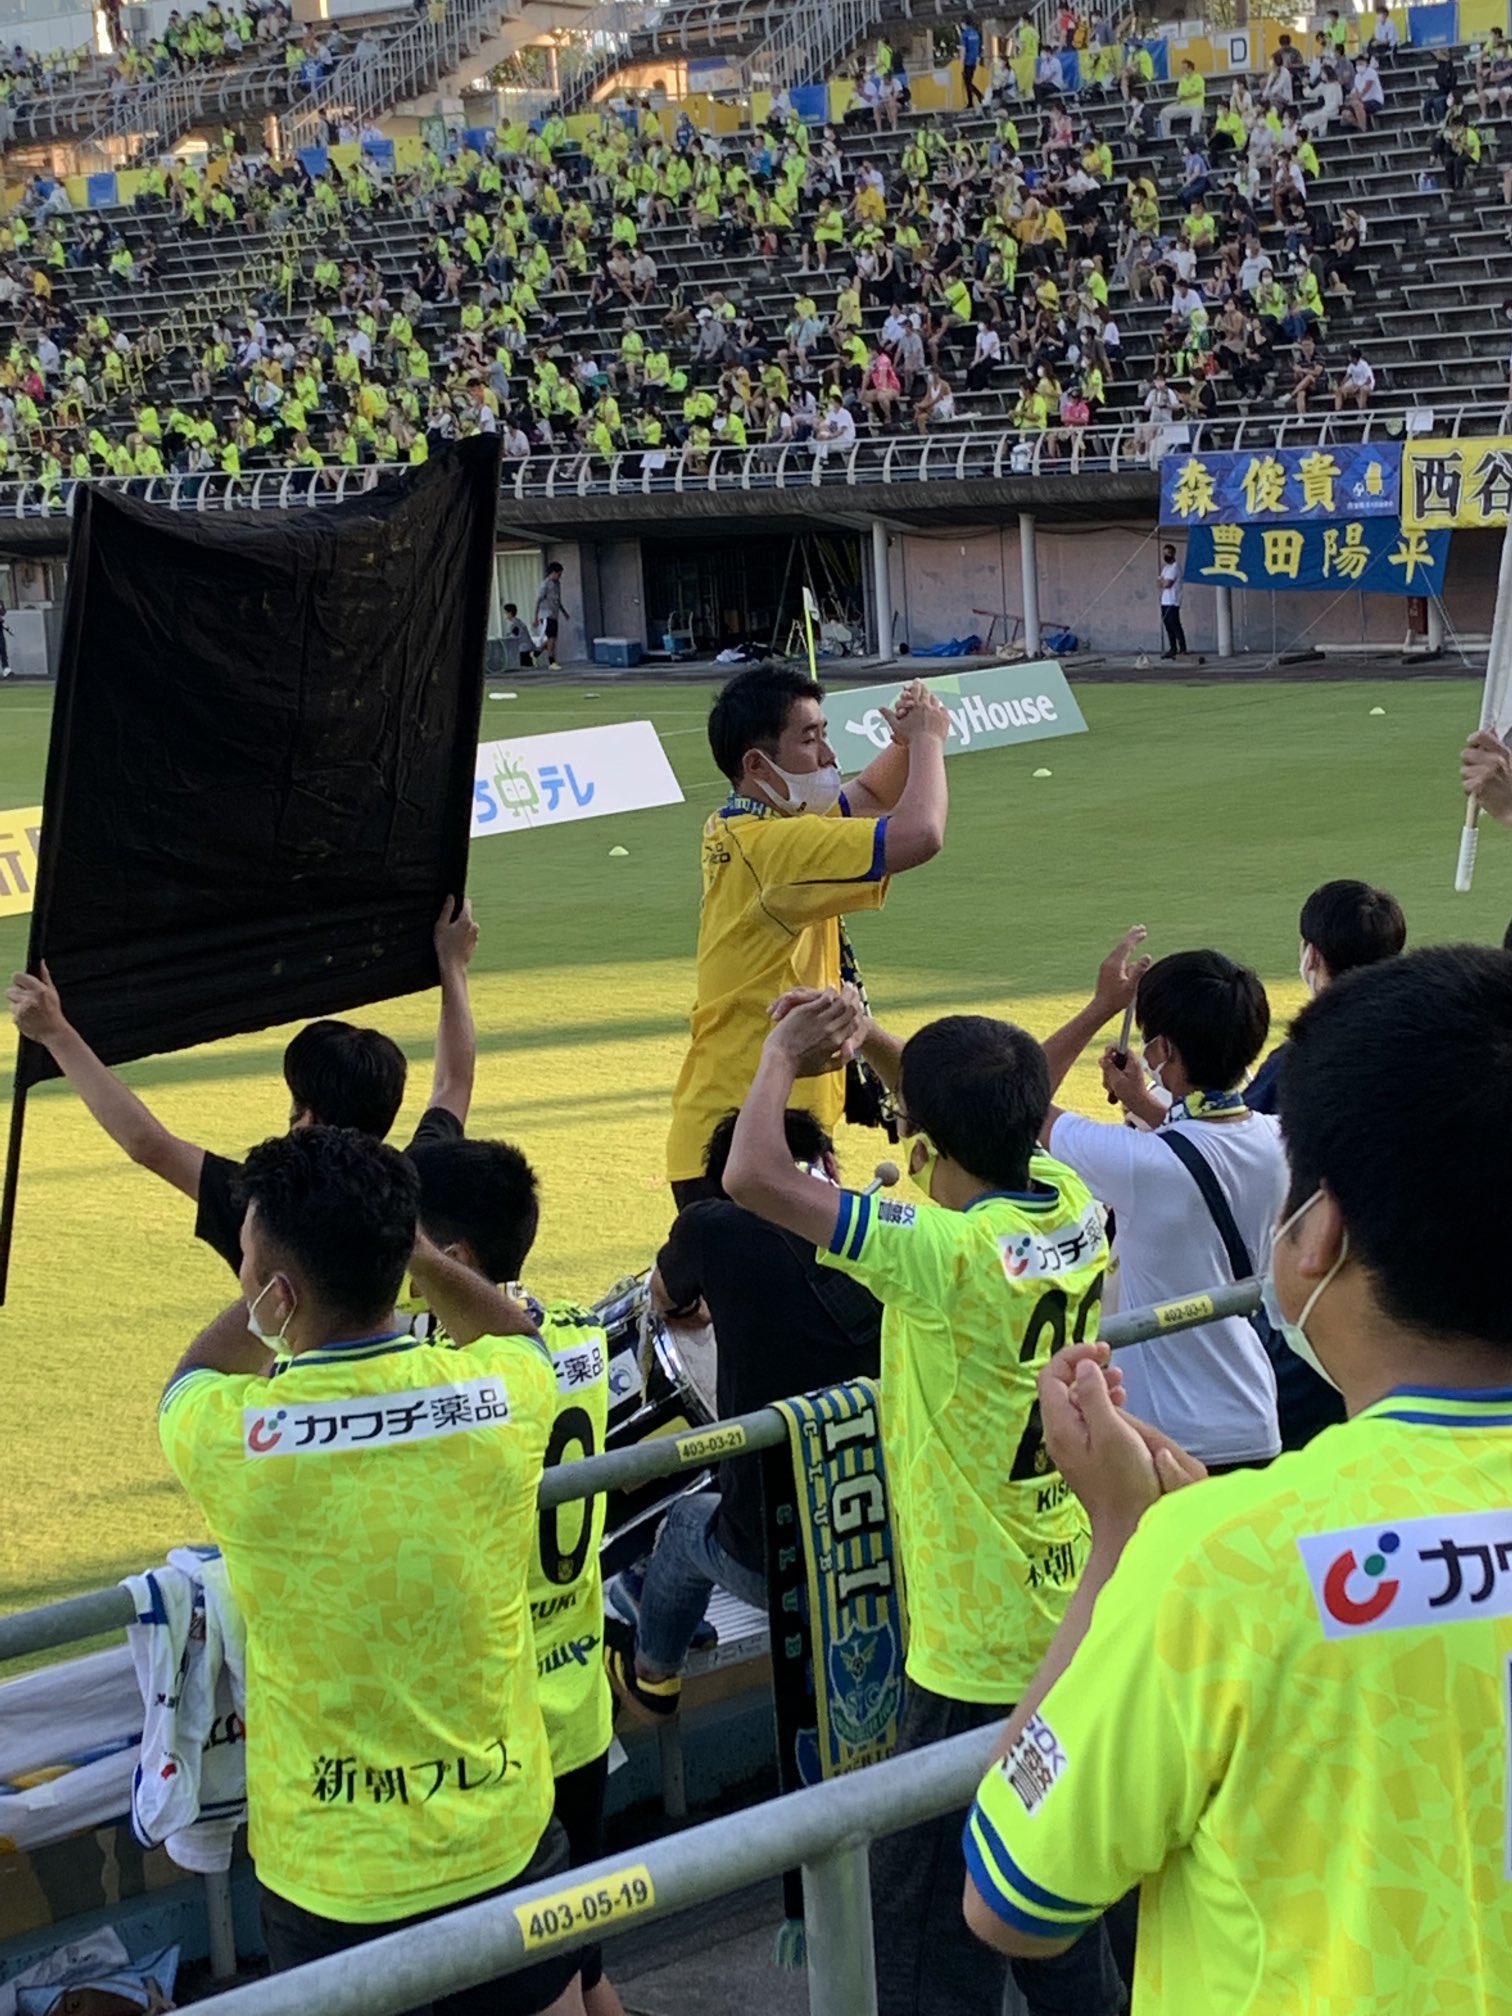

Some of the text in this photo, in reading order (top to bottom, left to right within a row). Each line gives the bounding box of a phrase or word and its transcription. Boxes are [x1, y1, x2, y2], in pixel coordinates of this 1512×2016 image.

[1231, 38, 1247, 62] D
[1172, 452, 1340, 518] 森俊貴
[1200, 522, 1434, 585] 豊田陽平
[294, 1388, 509, 1446] カワチ薬品
[682, 1431, 742, 1457] 403-03-21
[530, 1879, 648, 1938] 403-05-19
